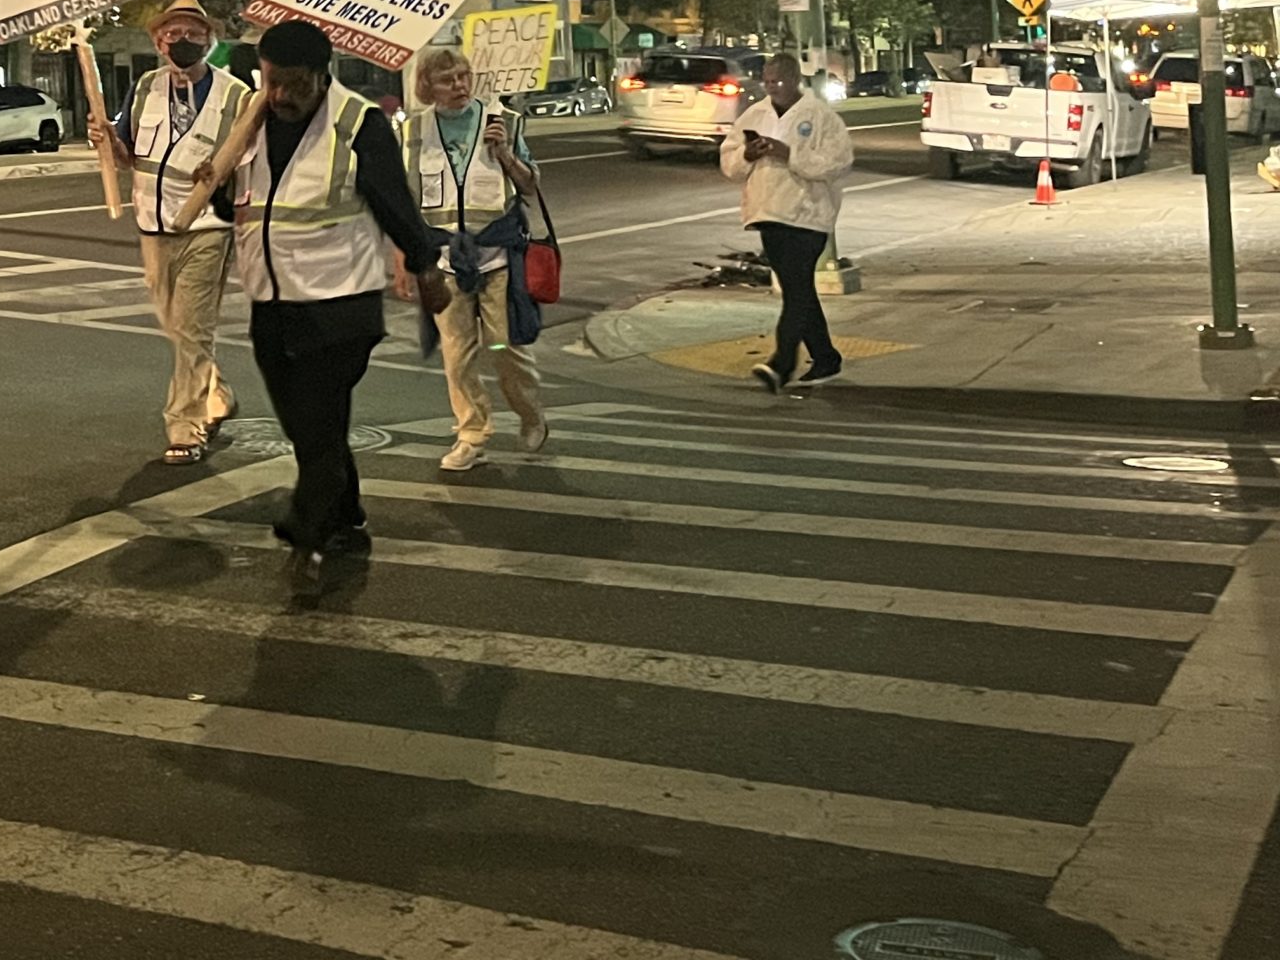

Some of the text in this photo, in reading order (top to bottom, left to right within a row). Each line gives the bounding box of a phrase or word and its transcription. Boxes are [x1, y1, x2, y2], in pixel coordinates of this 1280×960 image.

[335, 0, 402, 34] MERCY
[472, 11, 553, 47] PEACE
[472, 43, 544, 70] IN OUR
[473, 67, 543, 95] TREETS
